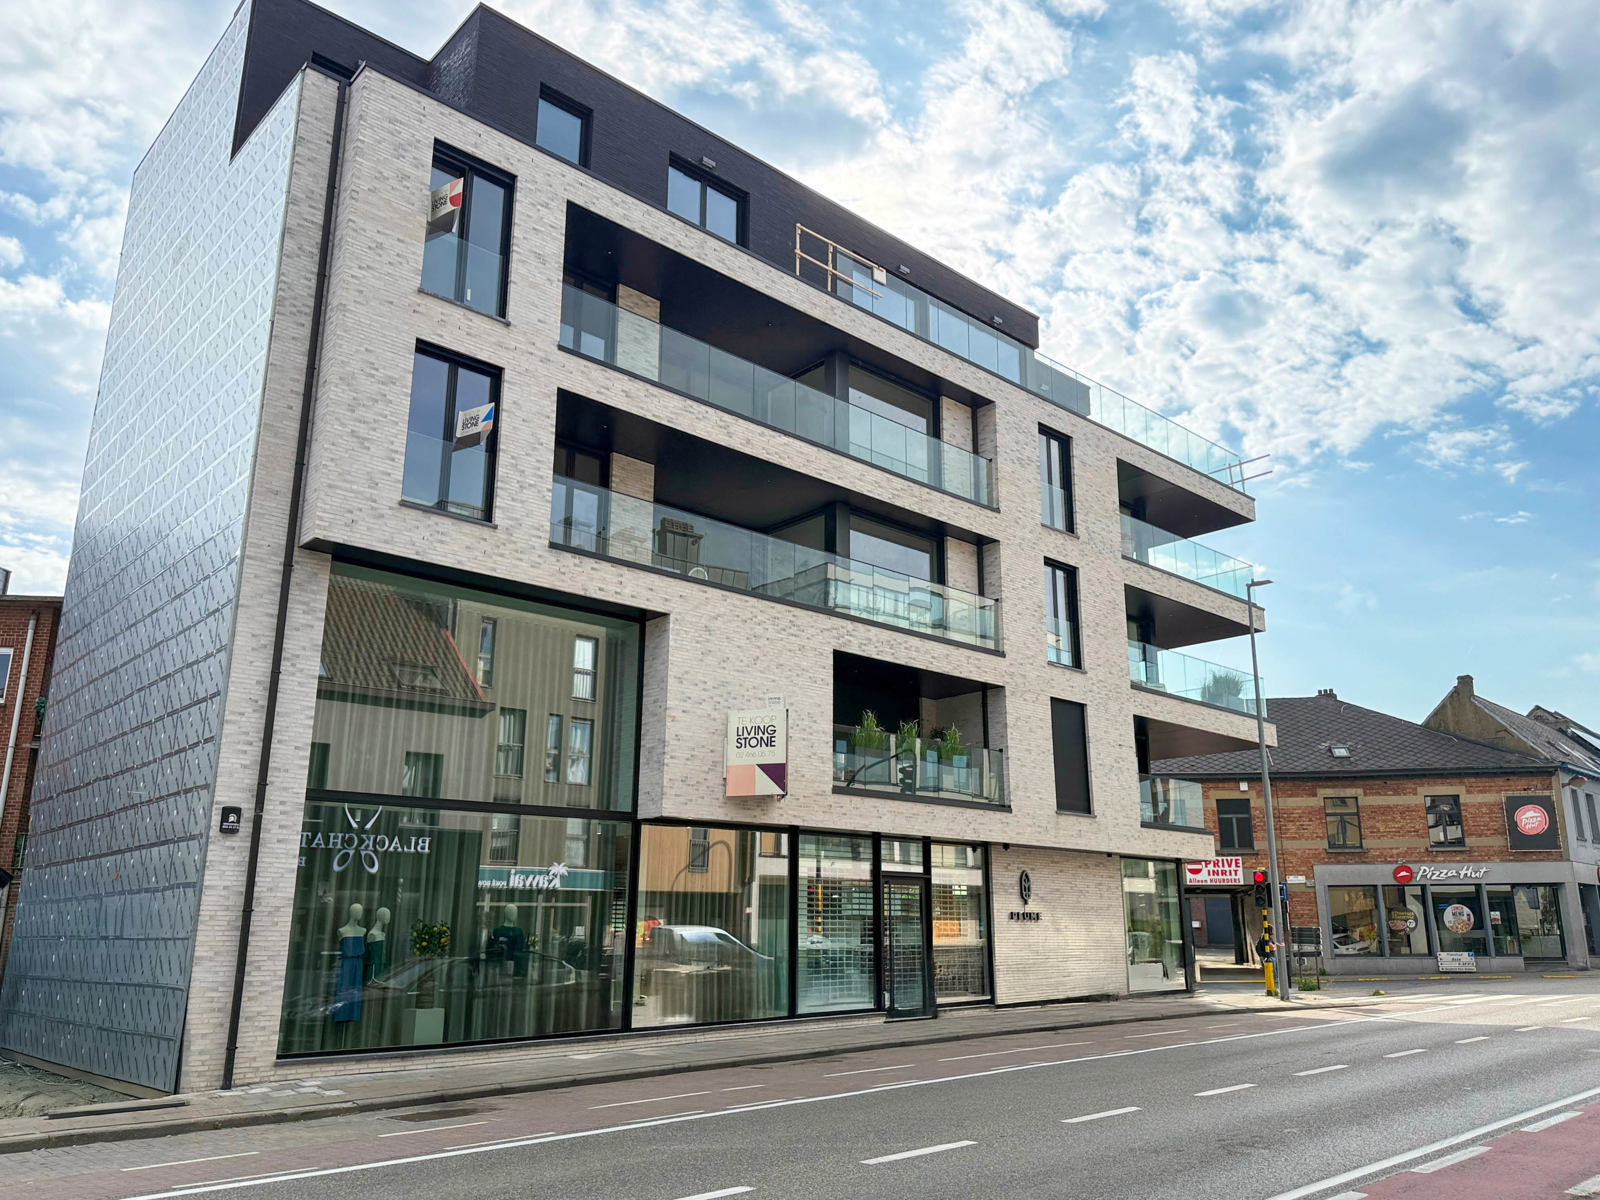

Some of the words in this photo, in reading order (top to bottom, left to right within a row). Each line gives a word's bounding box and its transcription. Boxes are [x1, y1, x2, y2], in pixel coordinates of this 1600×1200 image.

[463, 414, 480, 423] LIVING
[461, 422, 479, 431] STONE
[736, 725, 777, 737] LIVING
[735, 736, 777, 749] STONE
[1204, 858, 1241, 868] PRIVE
[1207, 869, 1239, 877] INRIT
[1416, 866, 1457, 881] Pizza
[1459, 865, 1492, 879] Hut
